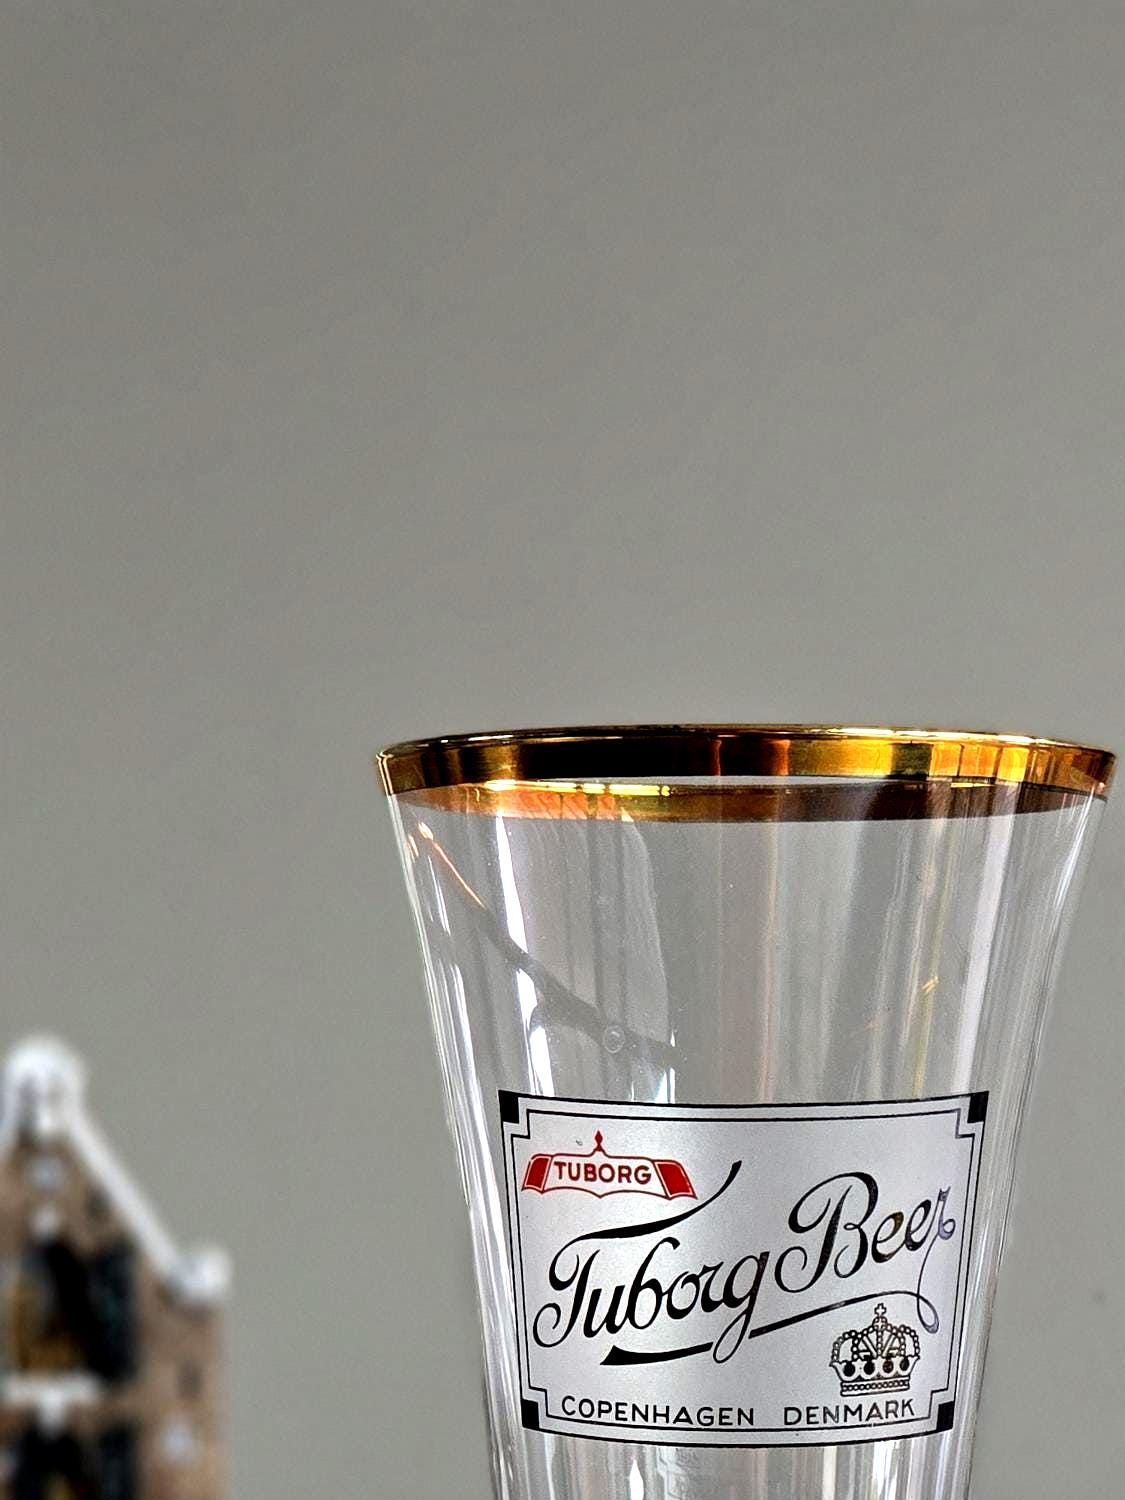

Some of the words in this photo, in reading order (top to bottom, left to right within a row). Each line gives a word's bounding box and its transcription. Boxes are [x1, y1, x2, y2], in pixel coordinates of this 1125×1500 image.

[553, 1161, 652, 1186] TUBORG
[532, 1160, 770, 1364] Tuborg
[774, 1171, 956, 1293] Beer
[561, 1395, 755, 1427] COPENHAGEN
[784, 1398, 916, 1426] DENMARK
